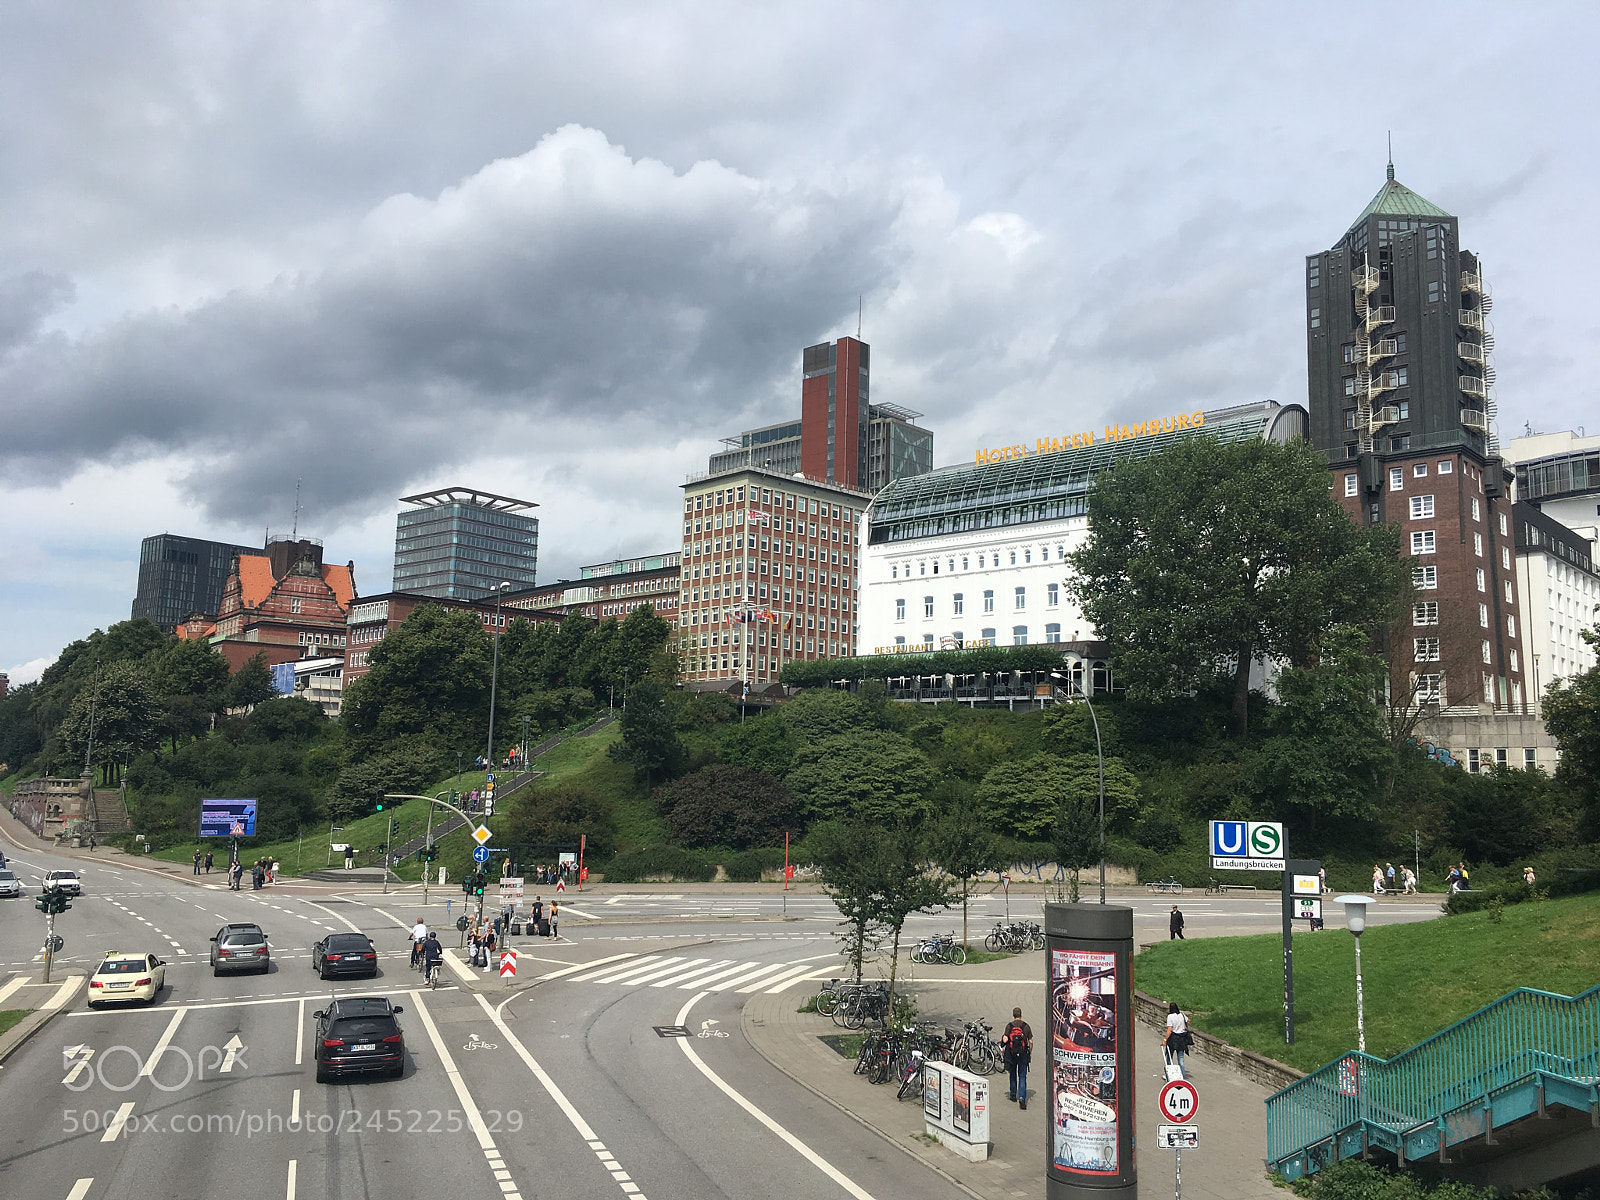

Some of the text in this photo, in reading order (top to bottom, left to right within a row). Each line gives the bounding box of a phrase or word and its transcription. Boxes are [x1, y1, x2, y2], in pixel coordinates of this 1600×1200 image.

[975, 410, 1204, 466] HOTEL HAFEN HAMBURG
[874, 642, 933, 655] RESTAURANT
[1218, 823, 1276, 853] U S
[1215, 859, 1284, 870] Landungsbrücken
[1054, 1048, 1115, 1061] SCHWERELOS
[1064, 1097, 1108, 1117] RESERVIEREN
[1077, 1097, 1097, 1107] JETZT
[1169, 1093, 1189, 1109] 4 m
